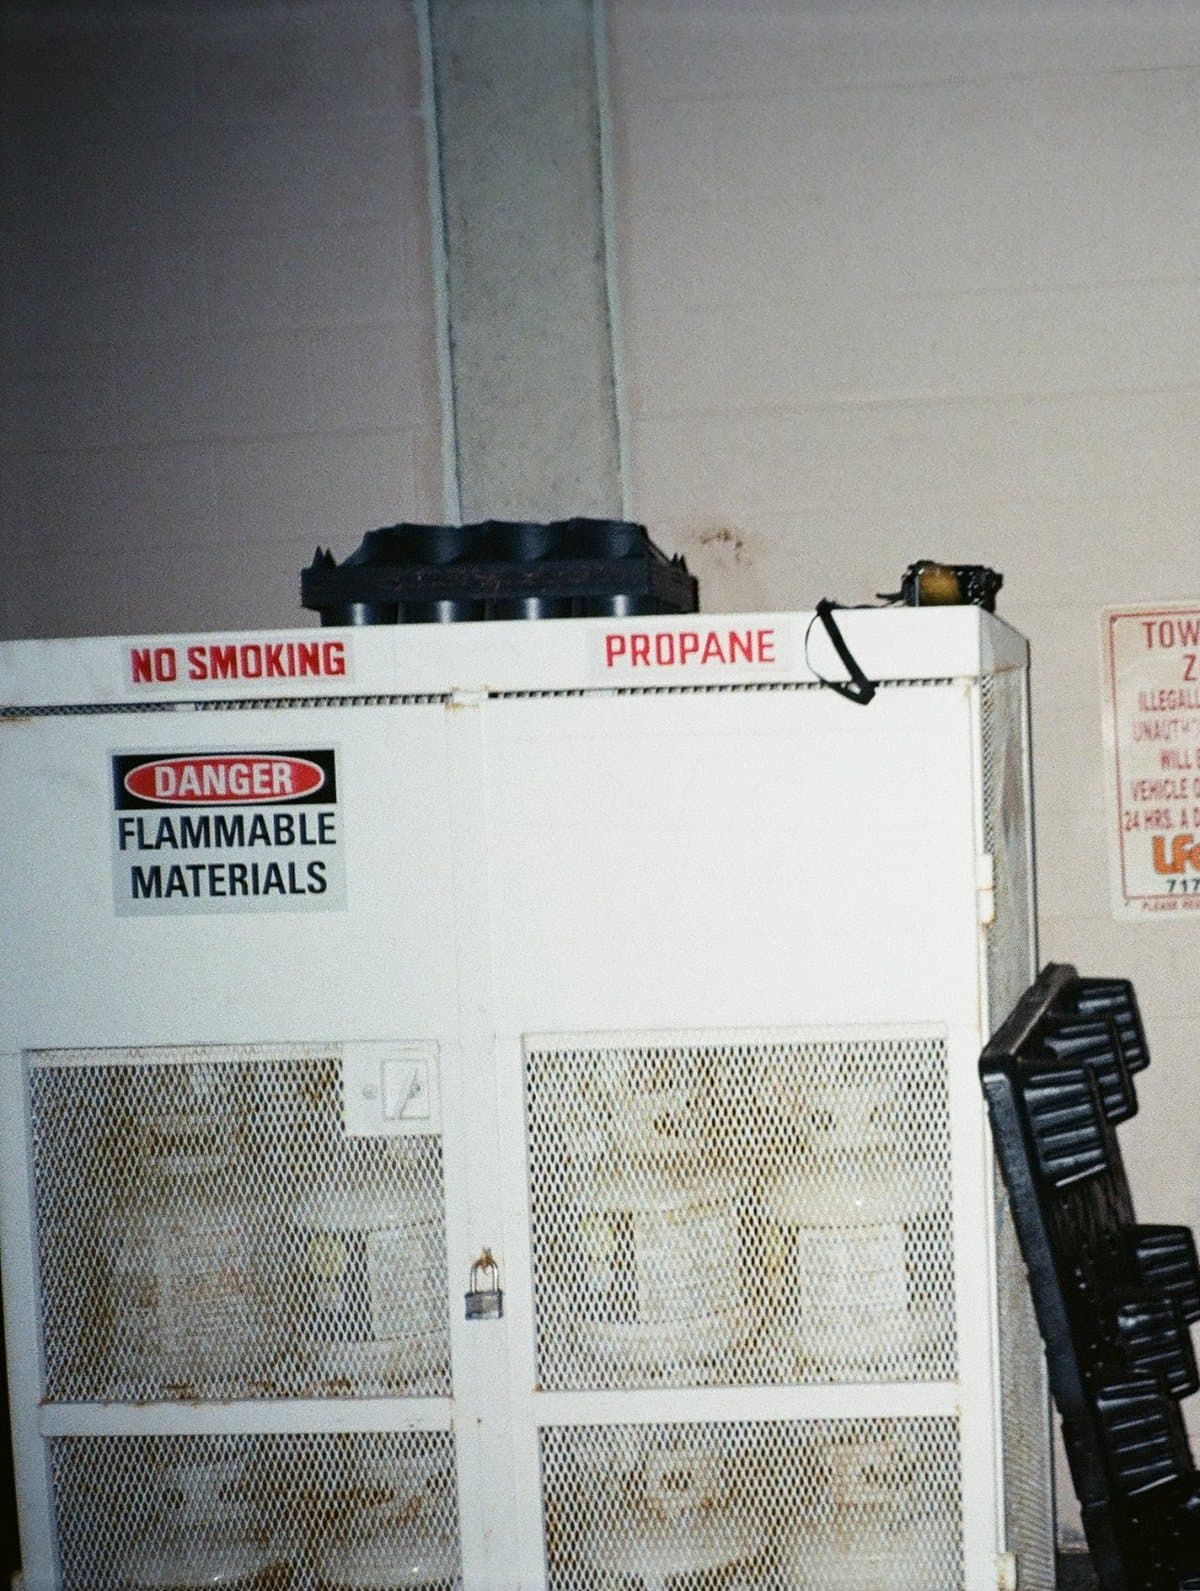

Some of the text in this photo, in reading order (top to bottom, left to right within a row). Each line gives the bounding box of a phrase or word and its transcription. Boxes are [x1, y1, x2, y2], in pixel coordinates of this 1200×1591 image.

[605, 630, 775, 667] PROPANE
[1142, 619, 1200, 648] TOW
[131, 641, 346, 683] NO SMOKING
[1160, 749, 1192, 769] WILL
[154, 761, 293, 797] DANGER
[1132, 778, 1189, 801] VEHICLE
[118, 812, 336, 850] FLAMMABLE
[1122, 808, 1140, 832] 24
[1180, 808, 1189, 827] A
[131, 861, 327, 899] MATERIALS
